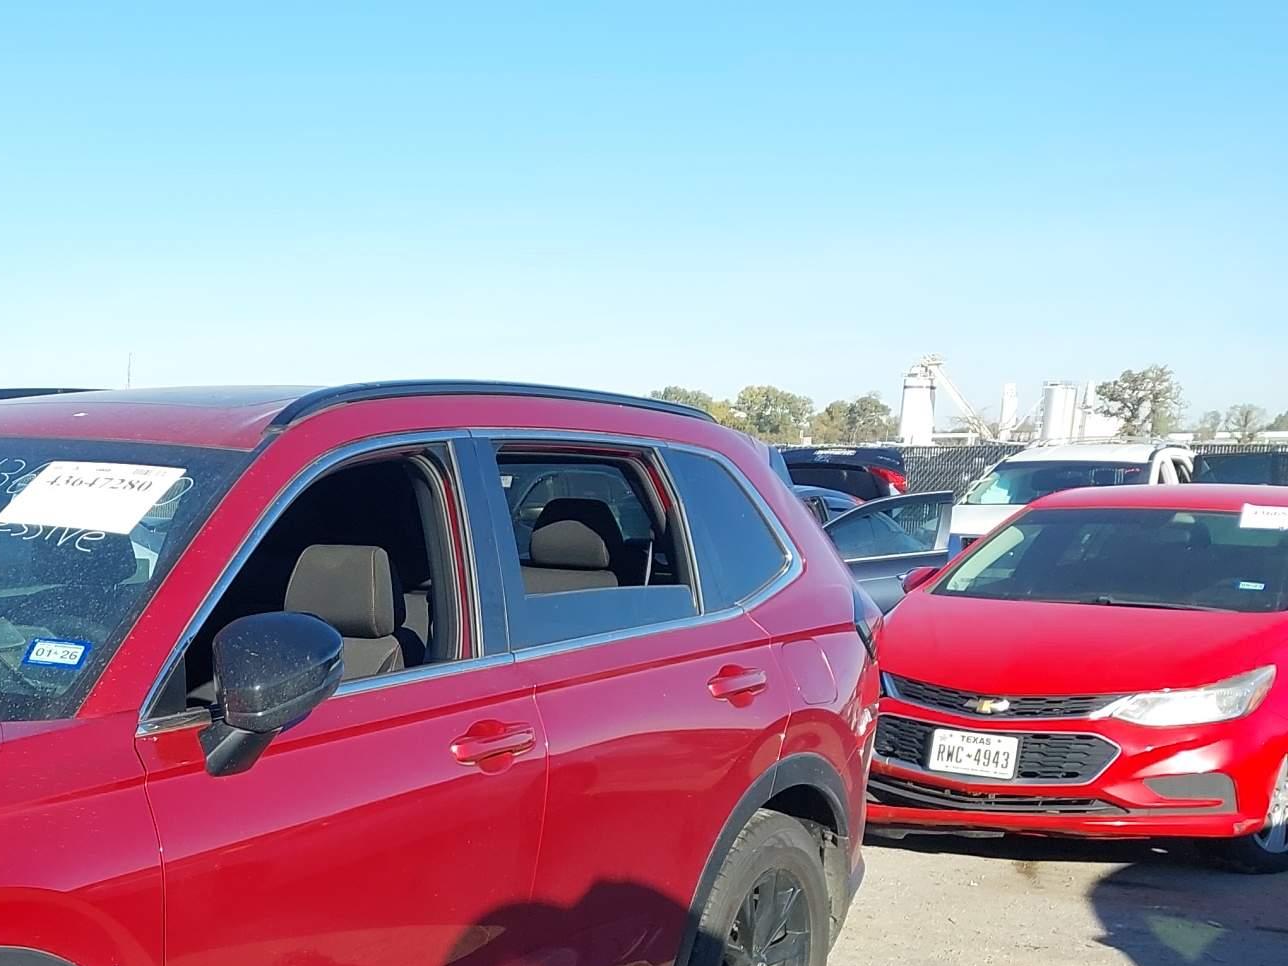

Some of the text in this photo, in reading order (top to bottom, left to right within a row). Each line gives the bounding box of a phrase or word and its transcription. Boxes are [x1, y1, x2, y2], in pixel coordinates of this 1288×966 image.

[46, 475, 153, 492] 43647280
[961, 735, 992, 745] TEXAS
[937, 744, 1010, 769] RWC 4943
